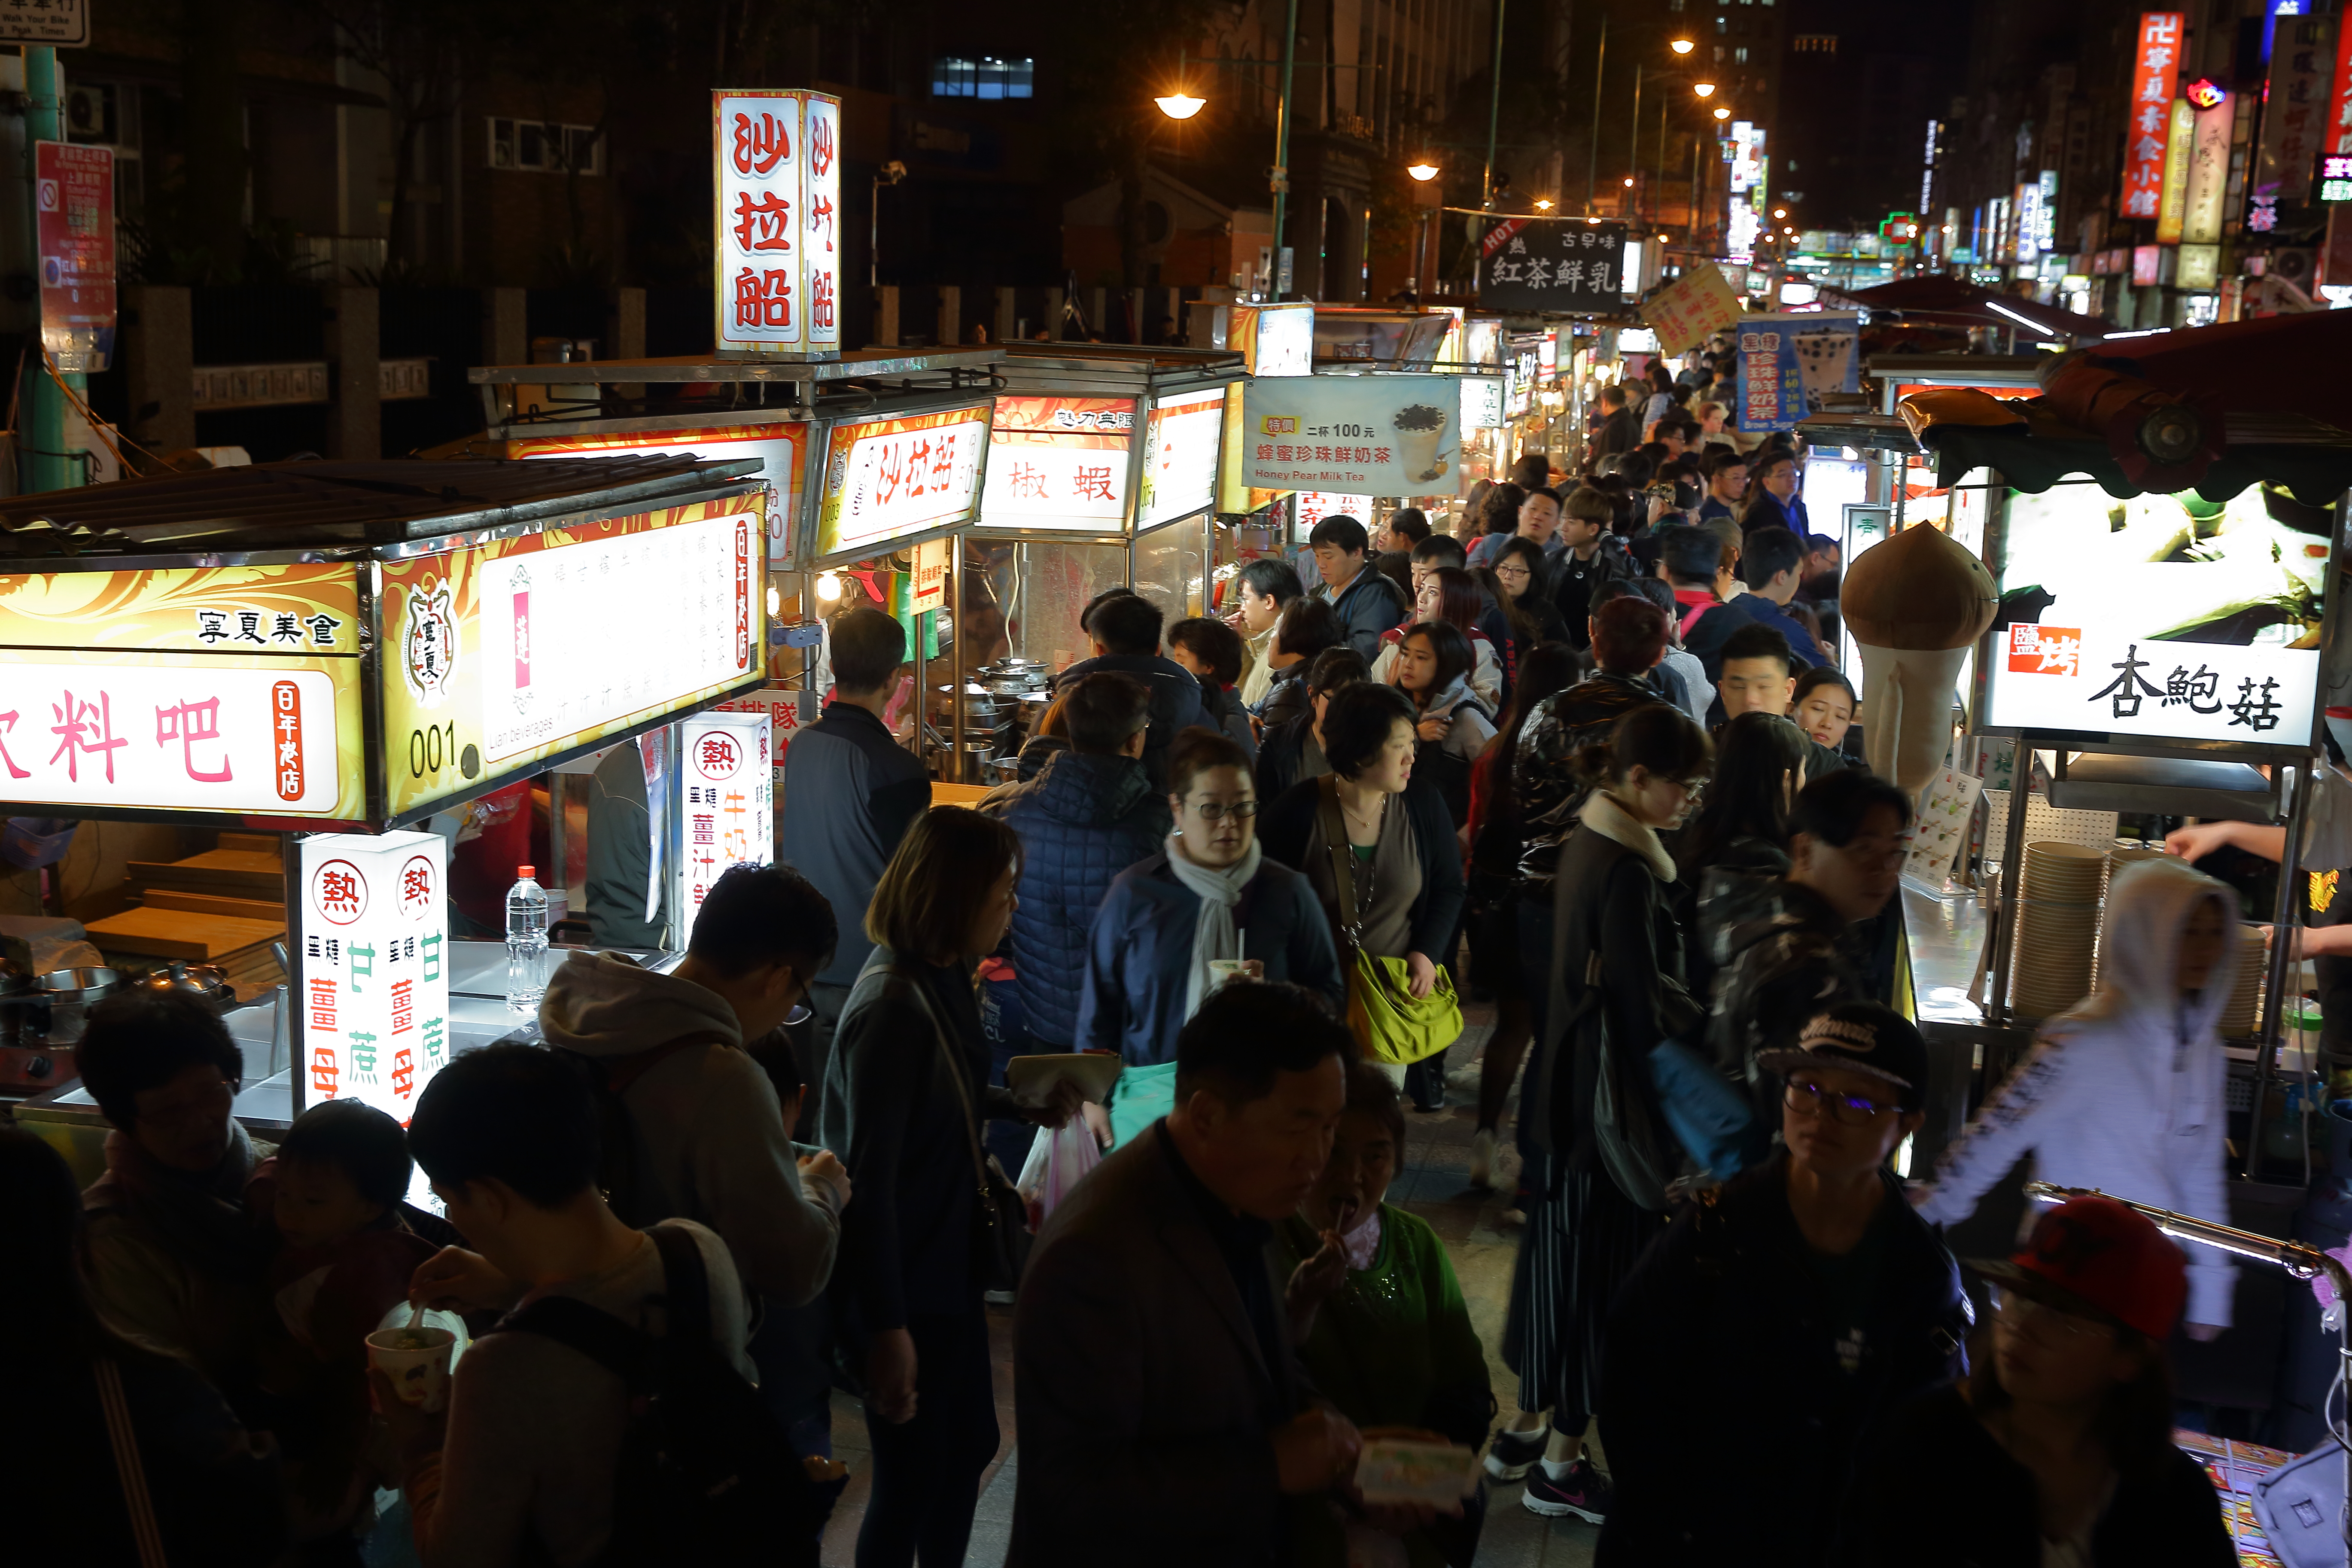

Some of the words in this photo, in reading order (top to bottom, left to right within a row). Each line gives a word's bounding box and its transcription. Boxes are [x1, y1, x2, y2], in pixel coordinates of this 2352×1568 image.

[27, 15, 46, 23] Your
[51, 15, 70, 24] Bike
[40, 26, 66, 35] Times
[733, 112, 791, 327] 沙拉船
[812, 115, 834, 328] 沙拉船
[1485, 220, 1514, 249] HOT
[1562, 231, 1616, 250] 古早味
[1491, 256, 1617, 294] 紅茶鮮乳
[1478, 384, 1499, 426] 青草茶
[1747, 353, 1778, 419] 珍珠鮮奶茶
[1057, 411, 1136, 429] 魅力無限
[1268, 418, 1295, 432] 特價
[1307, 426, 1330, 437] 二杯
[1333, 423, 1360, 437] 100
[1364, 427, 1375, 438] 元
[1744, 420, 1769, 429] Brown
[876, 434, 956, 506] 沙拉船
[1257, 443, 1391, 464] 蜂蜜珍珠鮮奶茶
[1009, 461, 1116, 502] 椒蝦
[1255, 469, 1289, 481] Honey
[1293, 470, 1317, 481] Pear
[1320, 471, 1342, 481] Milk
[1345, 472, 1365, 481] Tea
[825, 503, 840, 523] 003
[736, 526, 748, 664] 百年老店
[196, 611, 342, 644] 寧夏美食
[2088, 644, 2282, 732] 杏鮑菇
[274, 685, 300, 796] 百年老店
[411, 719, 455, 779] 001
[489, 729, 508, 750] Lian
[510, 716, 554, 743] beverages
[703, 740, 735, 771] 熱
[724, 789, 746, 863] 牛奶
[323, 871, 359, 913] 熱
[405, 867, 430, 910] 熱
[420, 929, 443, 1072] 甘蔗
